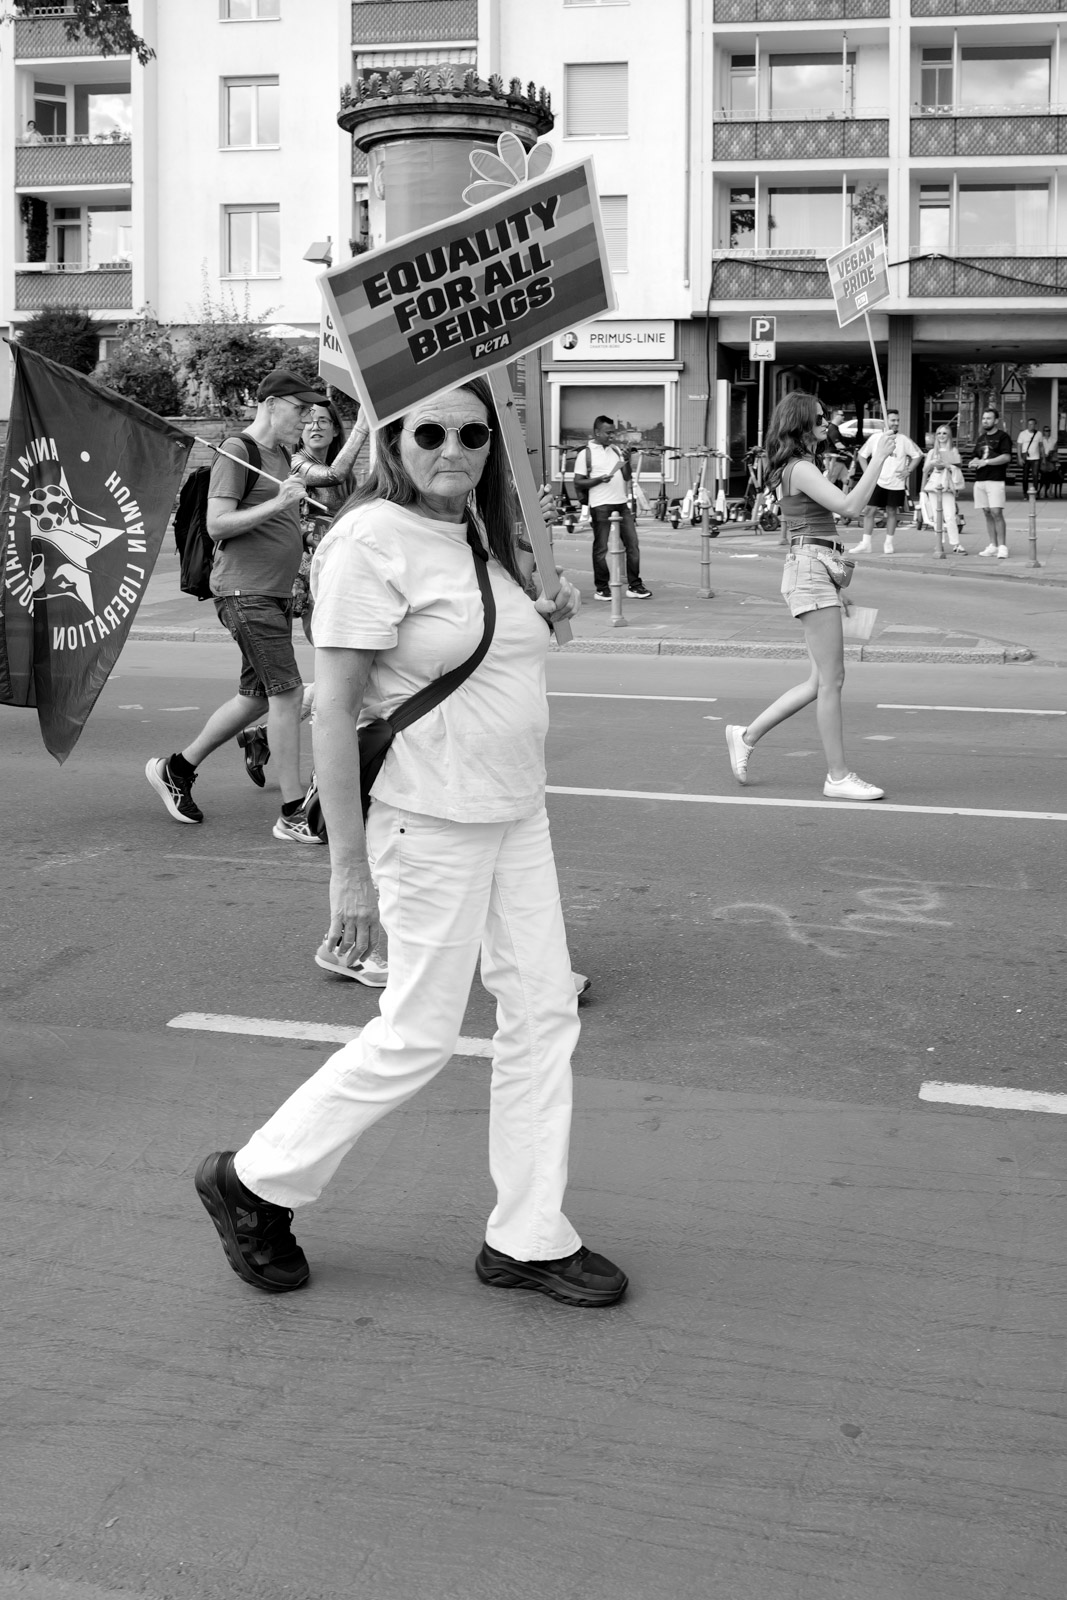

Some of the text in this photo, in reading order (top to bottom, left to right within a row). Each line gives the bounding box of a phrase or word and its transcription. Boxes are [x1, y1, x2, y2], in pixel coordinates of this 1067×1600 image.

[362, 195, 560, 309] EQUALITY
[836, 242, 876, 279] VEGAN
[393, 242, 553, 333] FOR ALL
[843, 264, 877, 299] PRIDE
[407, 276, 555, 365] BEINGS
[590, 333, 666, 343] PRIMUS-LINIE
[756, 320, 770, 339] P
